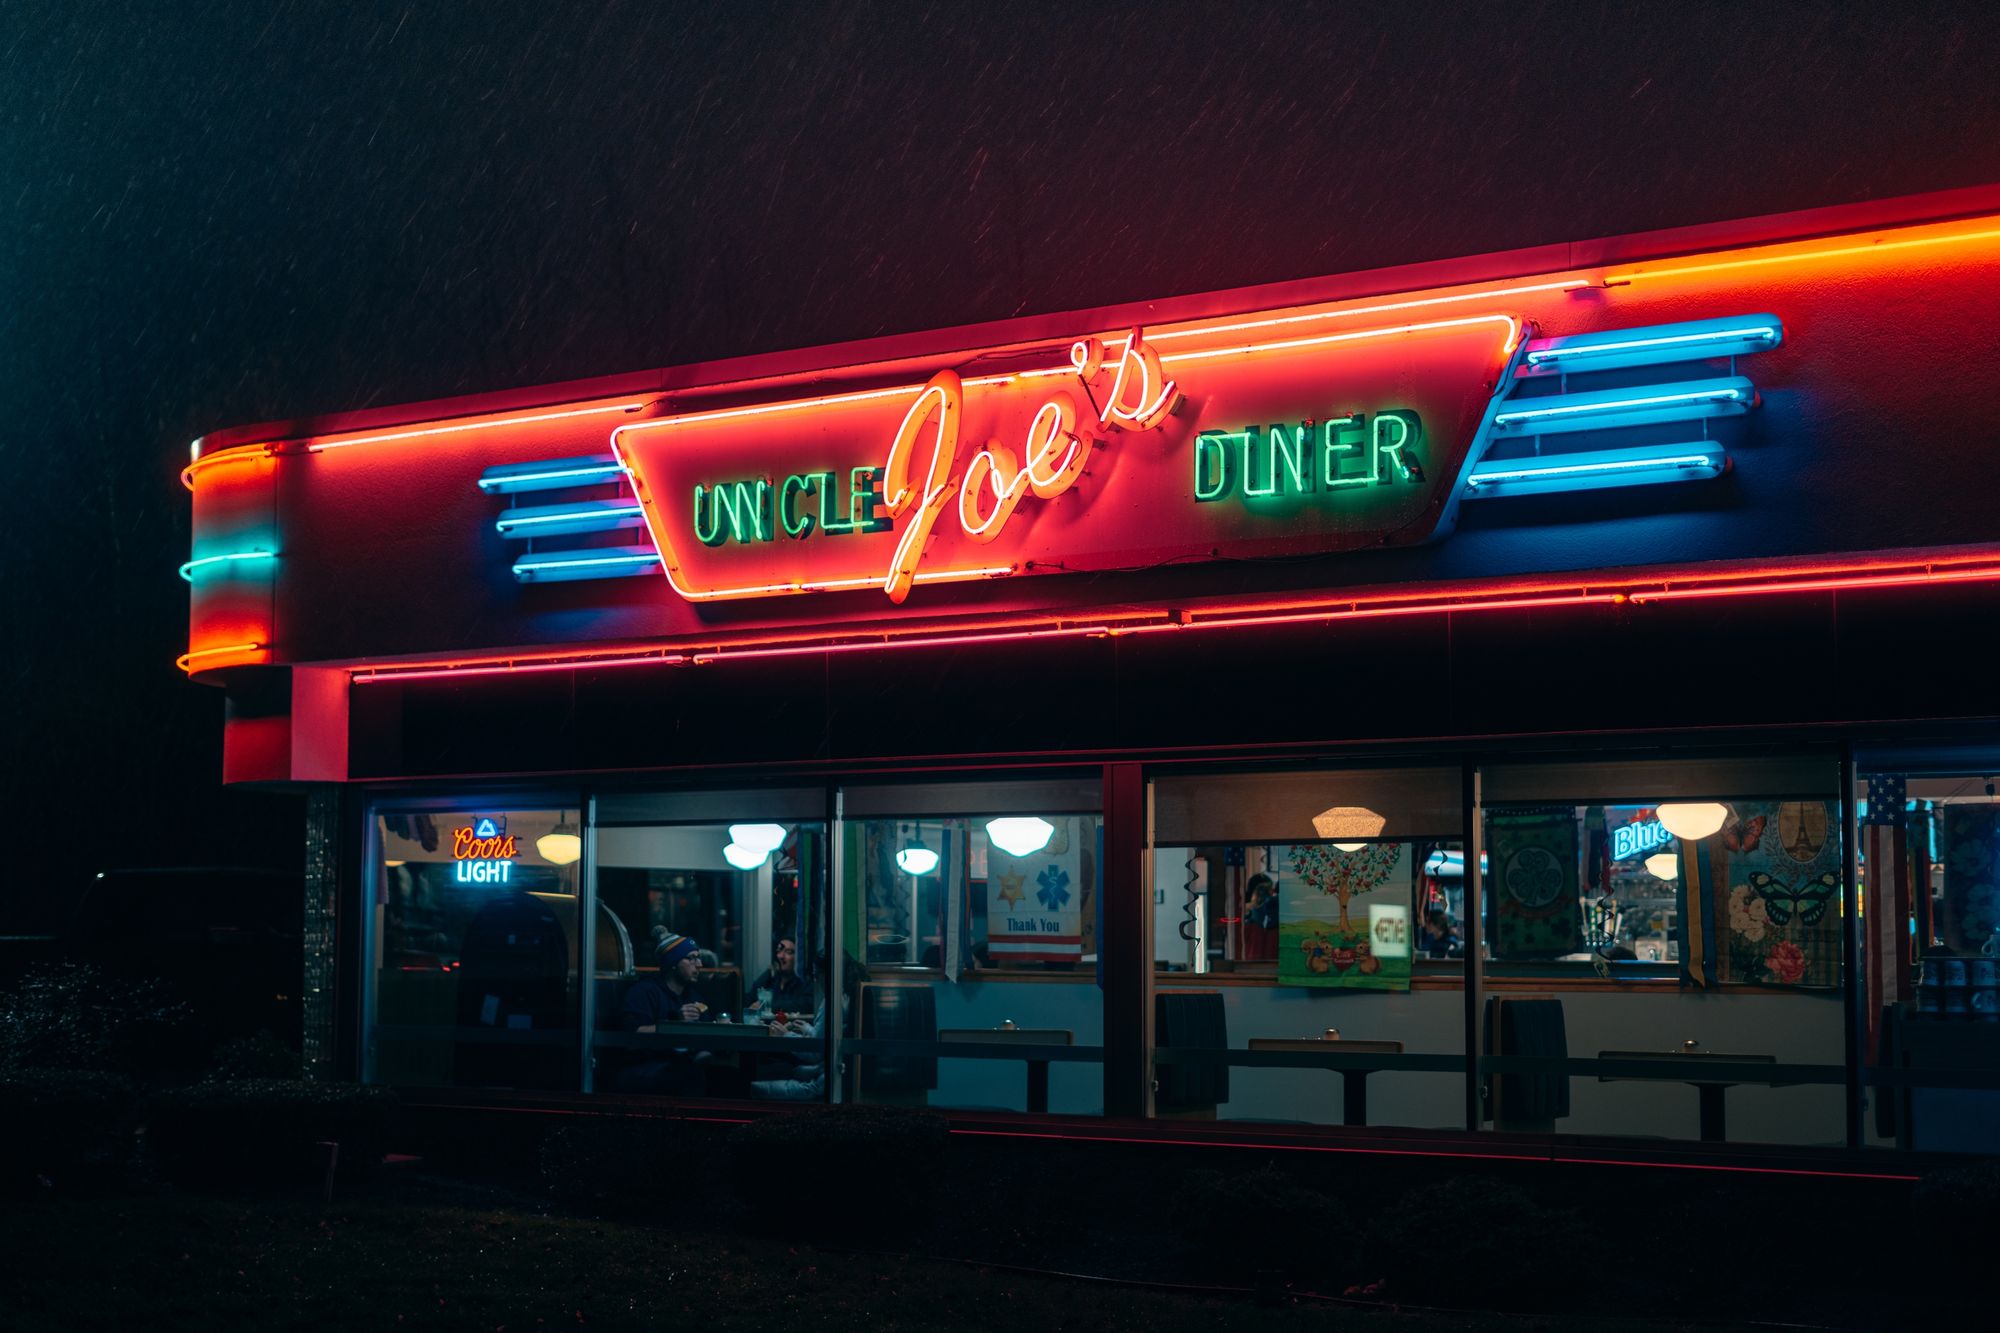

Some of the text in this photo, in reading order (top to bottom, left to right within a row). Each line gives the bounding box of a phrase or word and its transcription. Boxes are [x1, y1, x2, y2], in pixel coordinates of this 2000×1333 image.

[694, 326, 1426, 604] UNCLE Joe's DINER
[453, 827, 517, 859] Coors
[457, 860, 512, 883] LIGHT
[1006, 918, 1060, 932] Thank You
